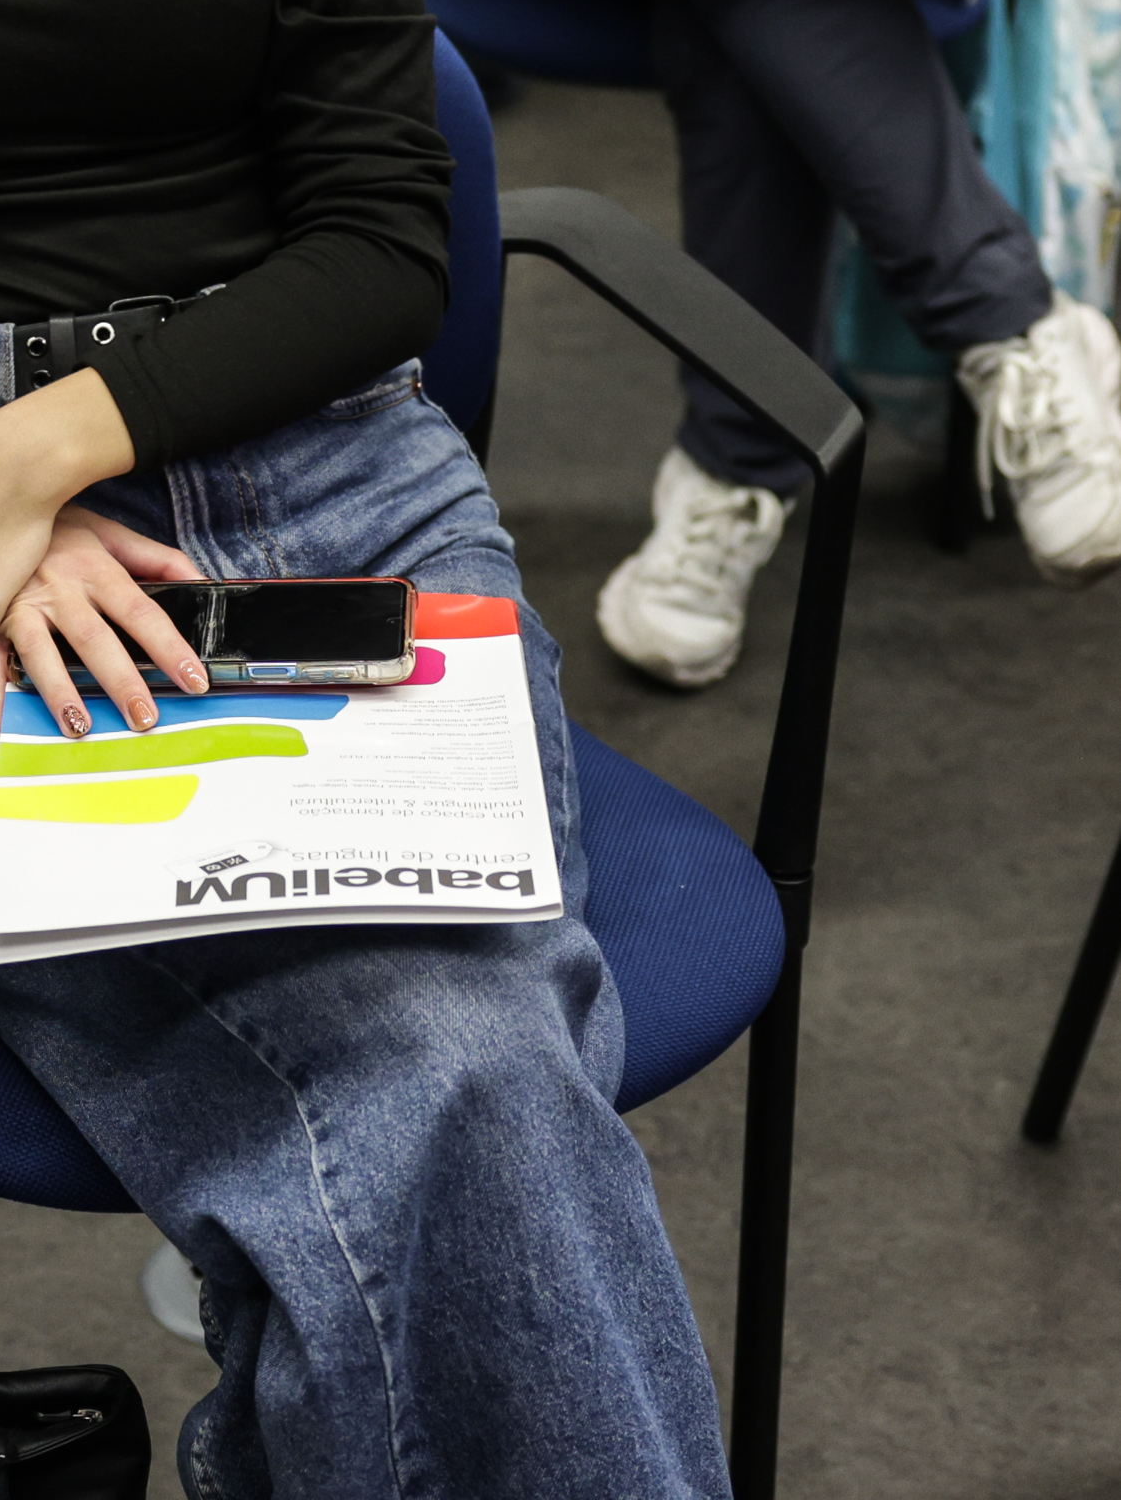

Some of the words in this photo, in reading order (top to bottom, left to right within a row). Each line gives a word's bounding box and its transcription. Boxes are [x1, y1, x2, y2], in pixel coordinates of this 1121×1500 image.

[290, 798, 395, 806] intercultural
[403, 799, 416, 807] &
[423, 799, 522, 810] multilingue
[299, 808, 384, 817] formação
[392, 809, 413, 817] de
[420, 809, 485, 819] espaço
[492, 810, 524, 819] Um
[291, 848, 389, 863] línguas
[400, 851, 433, 863] de
[445, 852, 530, 866] centro
[175, 868, 536, 907] babeliUM
